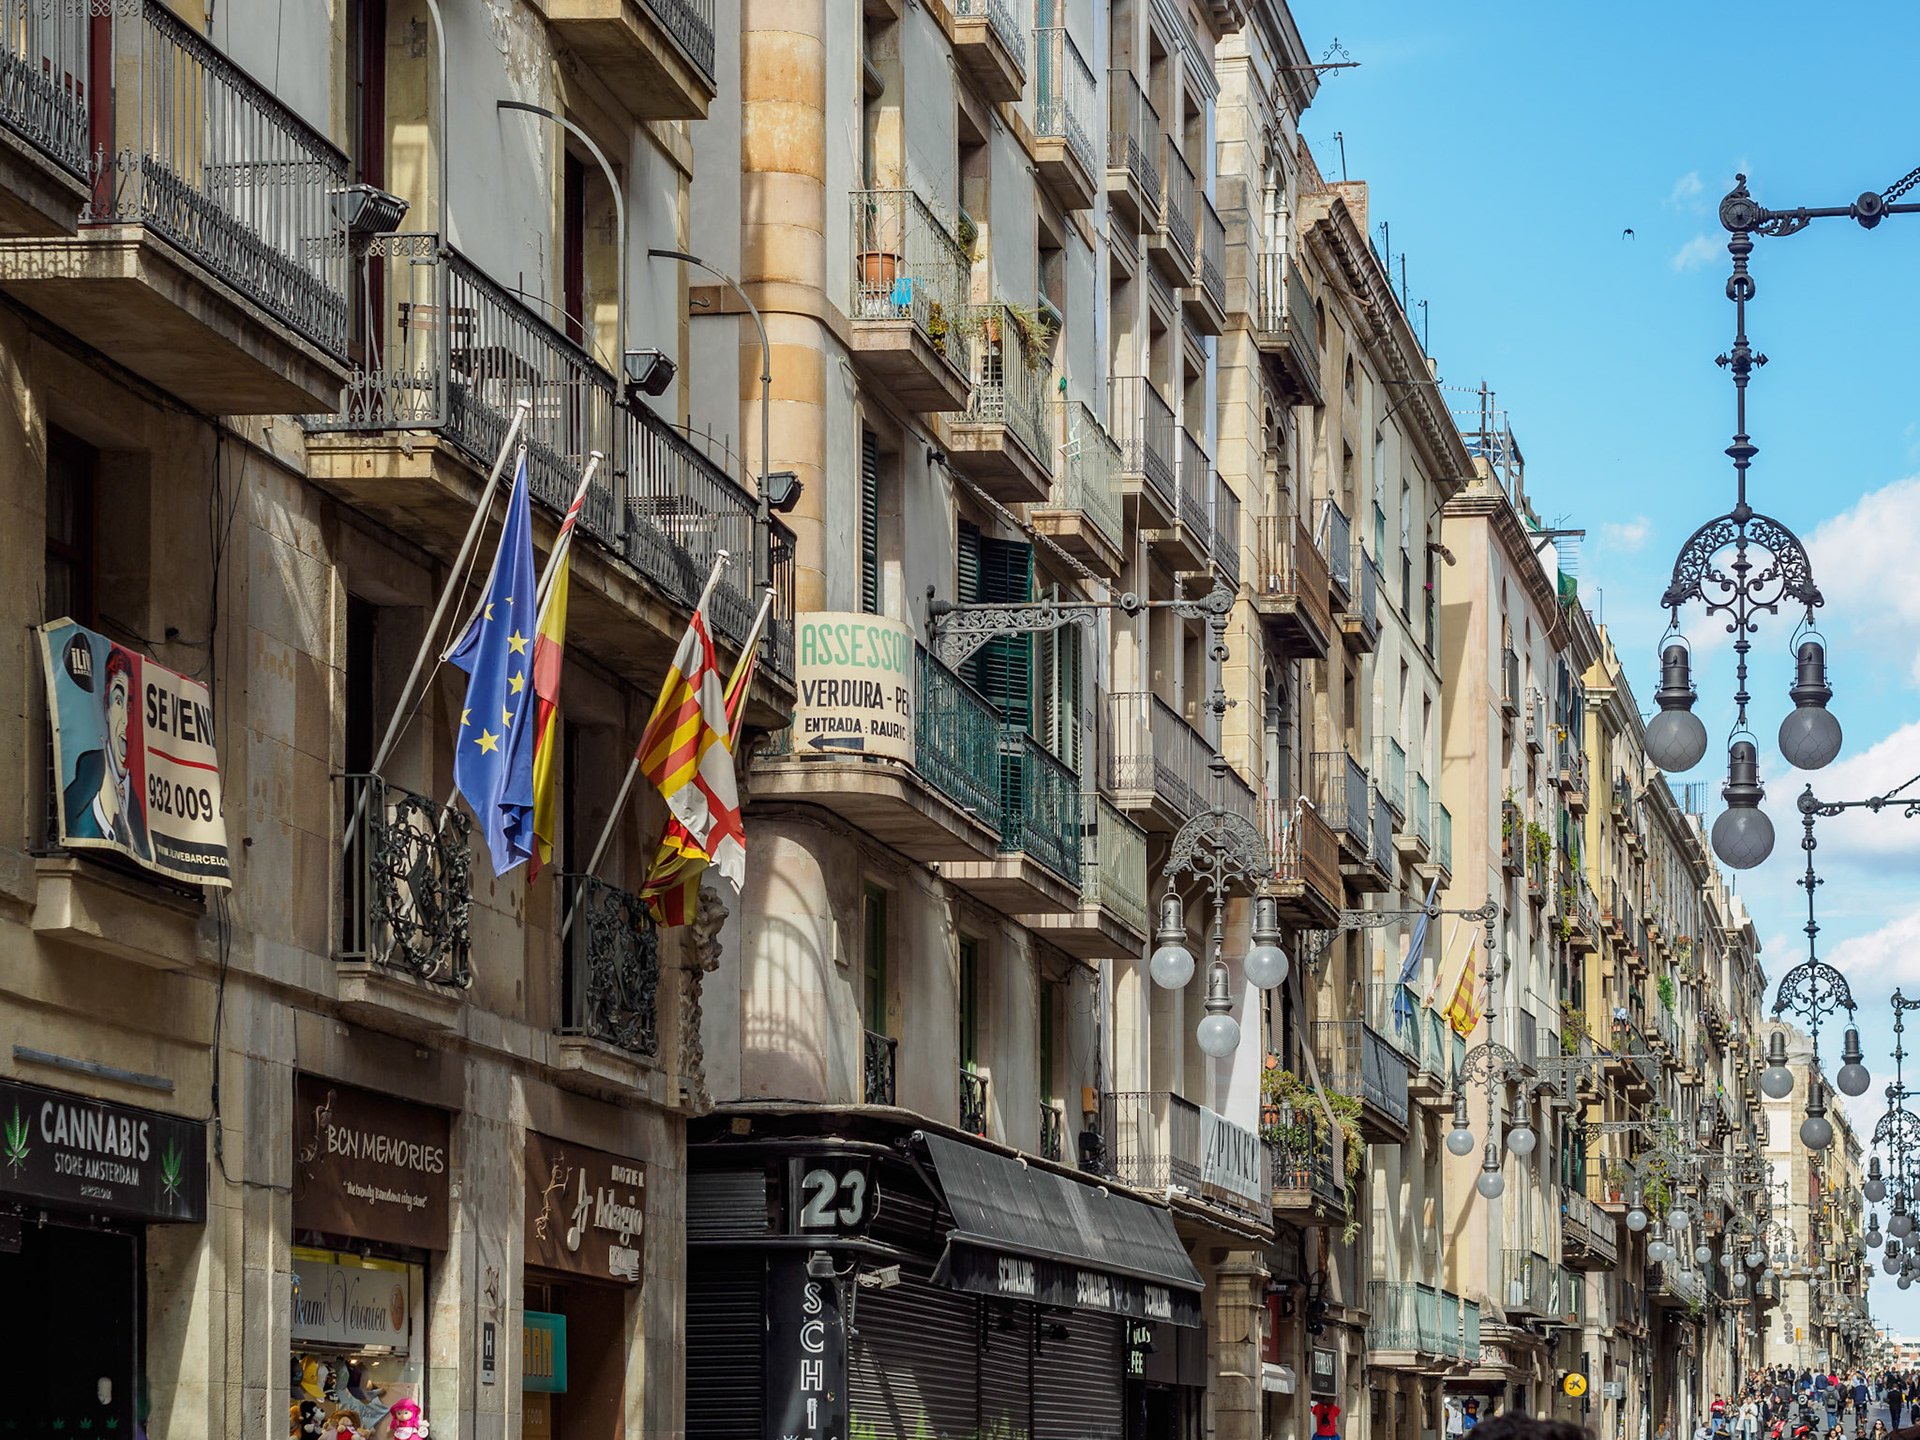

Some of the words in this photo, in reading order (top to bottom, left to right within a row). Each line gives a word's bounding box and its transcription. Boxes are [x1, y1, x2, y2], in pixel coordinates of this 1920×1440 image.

[801, 679, 883, 710] VERDURA
[871, 719, 906, 741] RAURIC
[41, 1101, 149, 1162] CANNABIS
[327, 1124, 358, 1153] BCN
[363, 1132, 444, 1174] MEMORIES
[55, 1152, 83, 1176] STORE
[85, 1159, 140, 1186] AMSTERDAM
[611, 1165, 645, 1187] HOTEL
[593, 1187, 643, 1246] Adagio
[800, 1169, 866, 1228] 23
[800, 1282, 825, 1440] SCHI
